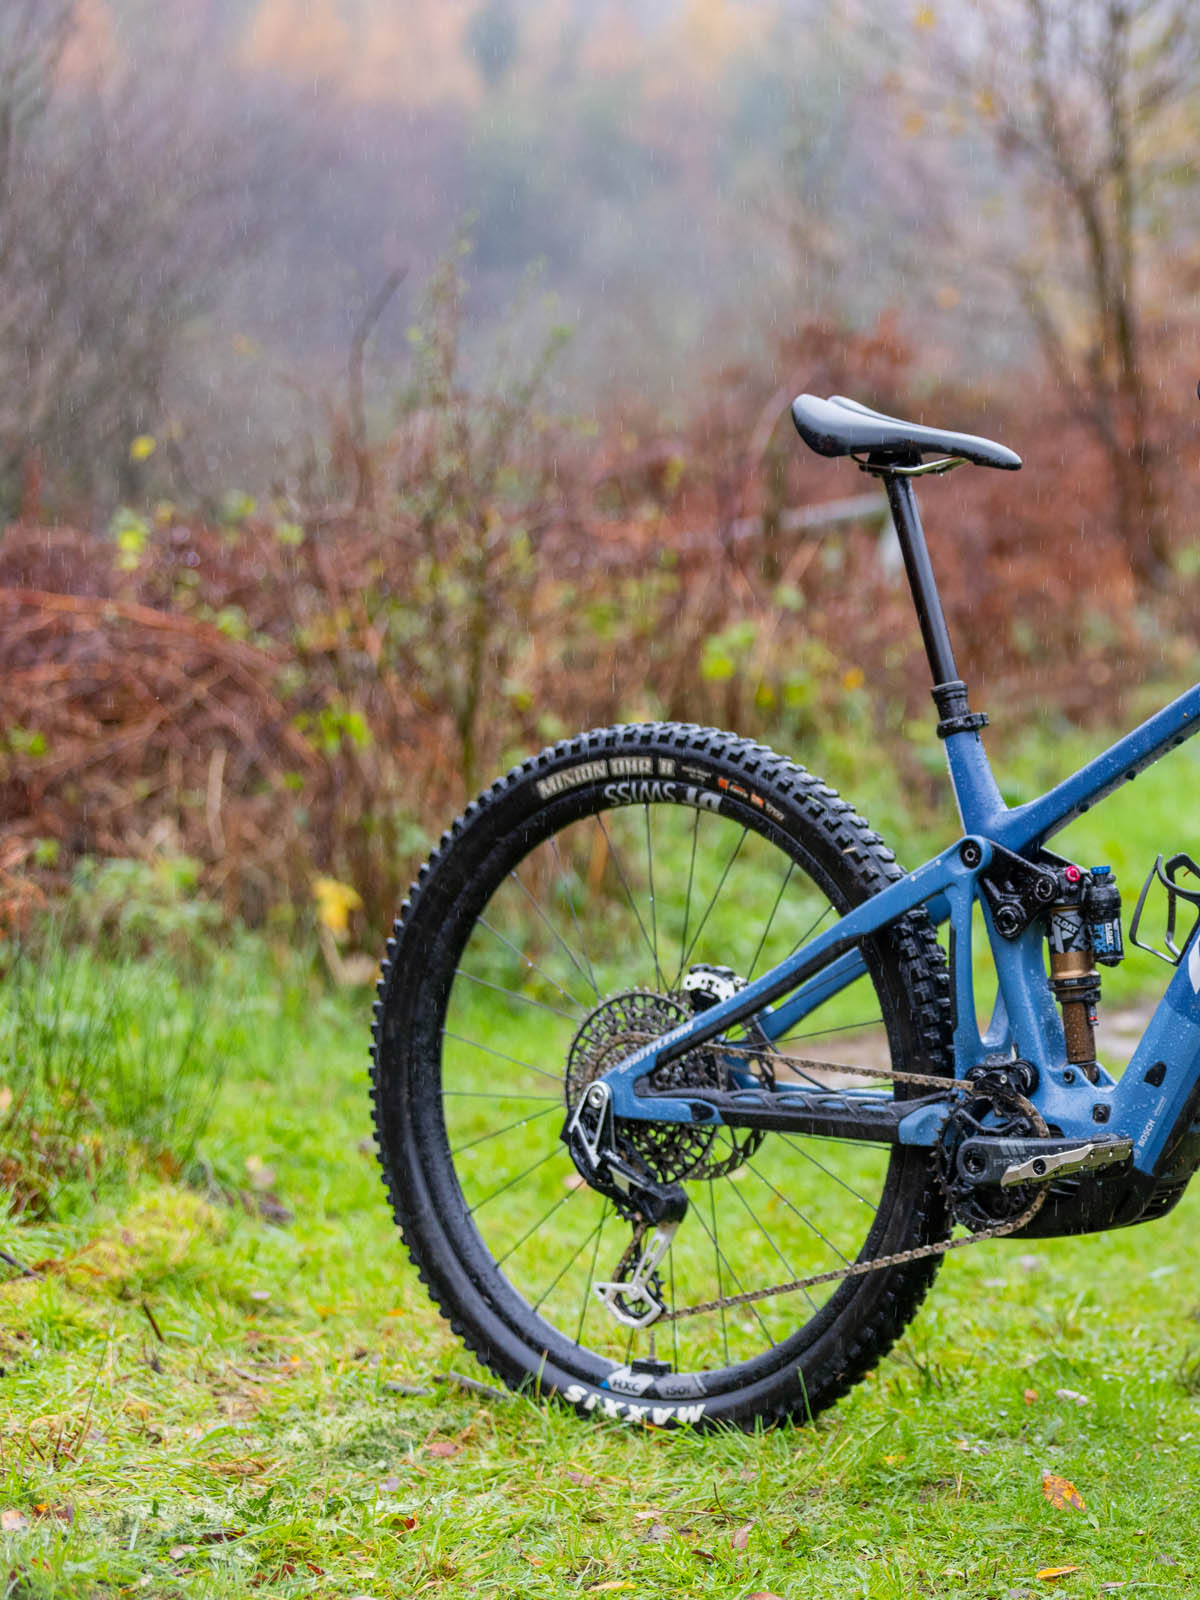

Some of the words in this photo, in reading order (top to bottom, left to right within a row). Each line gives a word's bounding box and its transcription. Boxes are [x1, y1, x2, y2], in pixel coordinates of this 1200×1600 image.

[536, 759, 608, 800] MINION
[604, 782, 677, 806] SWISS
[1137, 1119, 1156, 1148] BOSCH
[612, 1378, 641, 1393] HXC
[563, 1384, 706, 1426] MAXXIS
